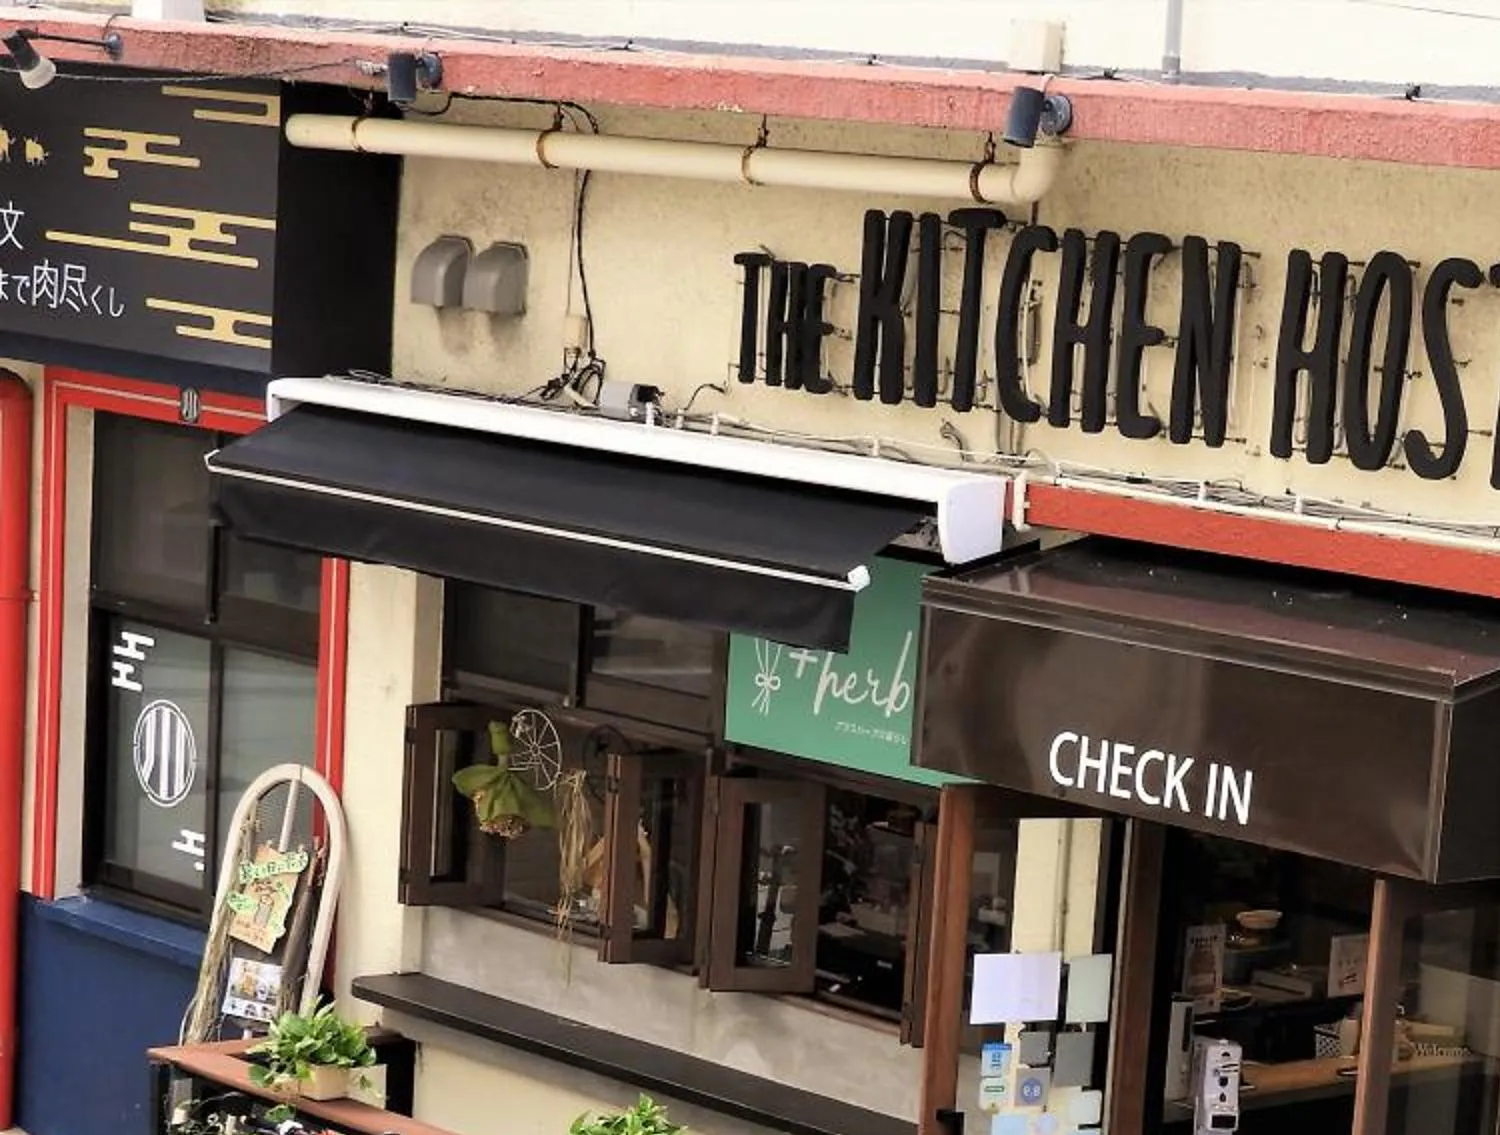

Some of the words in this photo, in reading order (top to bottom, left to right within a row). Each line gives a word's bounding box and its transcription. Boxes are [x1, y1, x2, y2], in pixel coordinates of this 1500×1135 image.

[734, 249, 838, 394] THE
[852, 207, 1244, 449] KITCHEN
[1049, 730, 1195, 813] CHECK
[1204, 762, 1254, 826] IN
